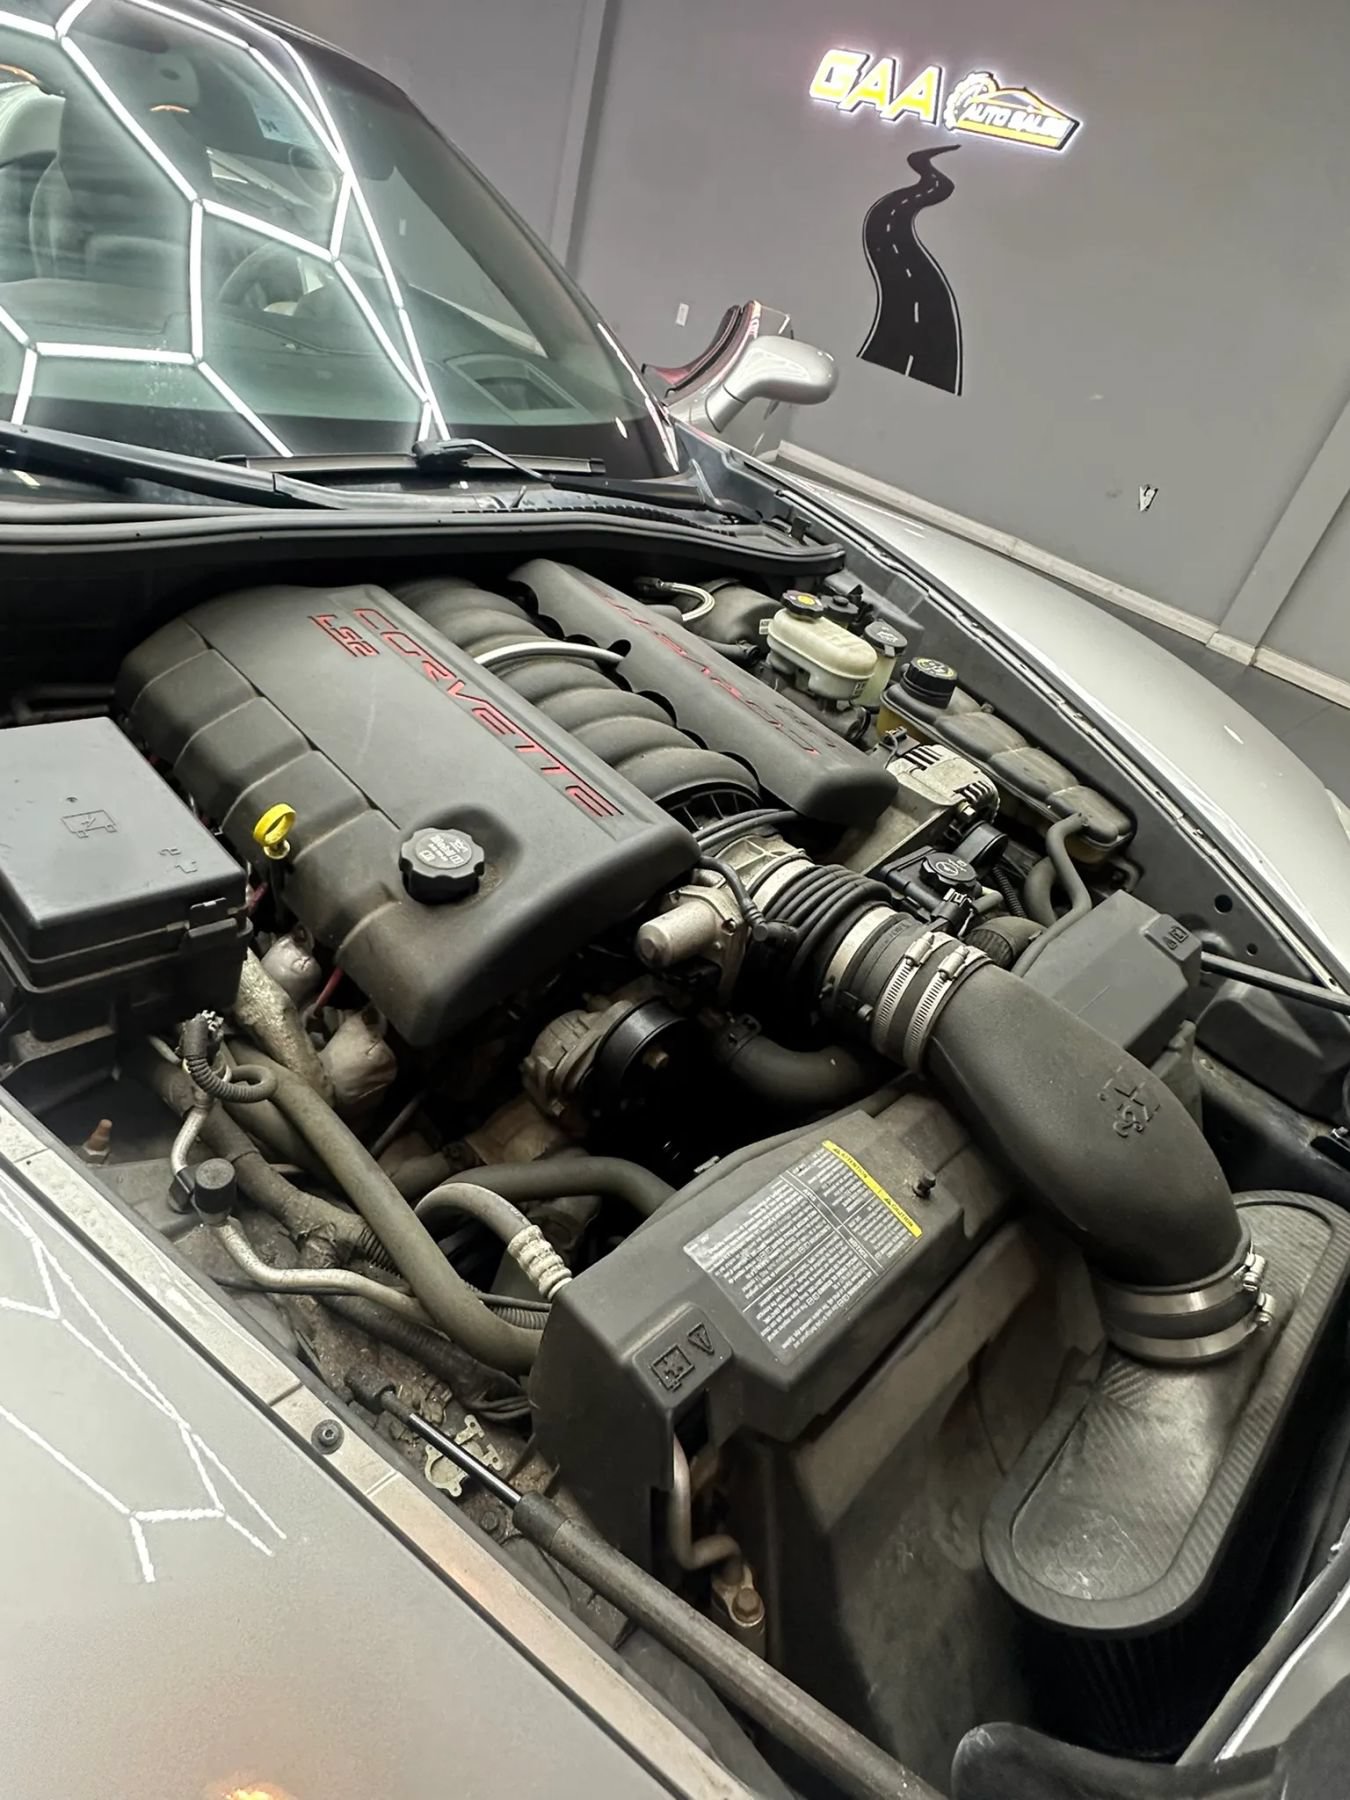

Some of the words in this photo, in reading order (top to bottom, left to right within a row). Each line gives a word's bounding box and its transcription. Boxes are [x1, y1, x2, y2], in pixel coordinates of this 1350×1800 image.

[809, 48, 942, 124] GAA
[962, 102, 1012, 127] AUTO
[353, 608, 625, 817] CORVETTE
